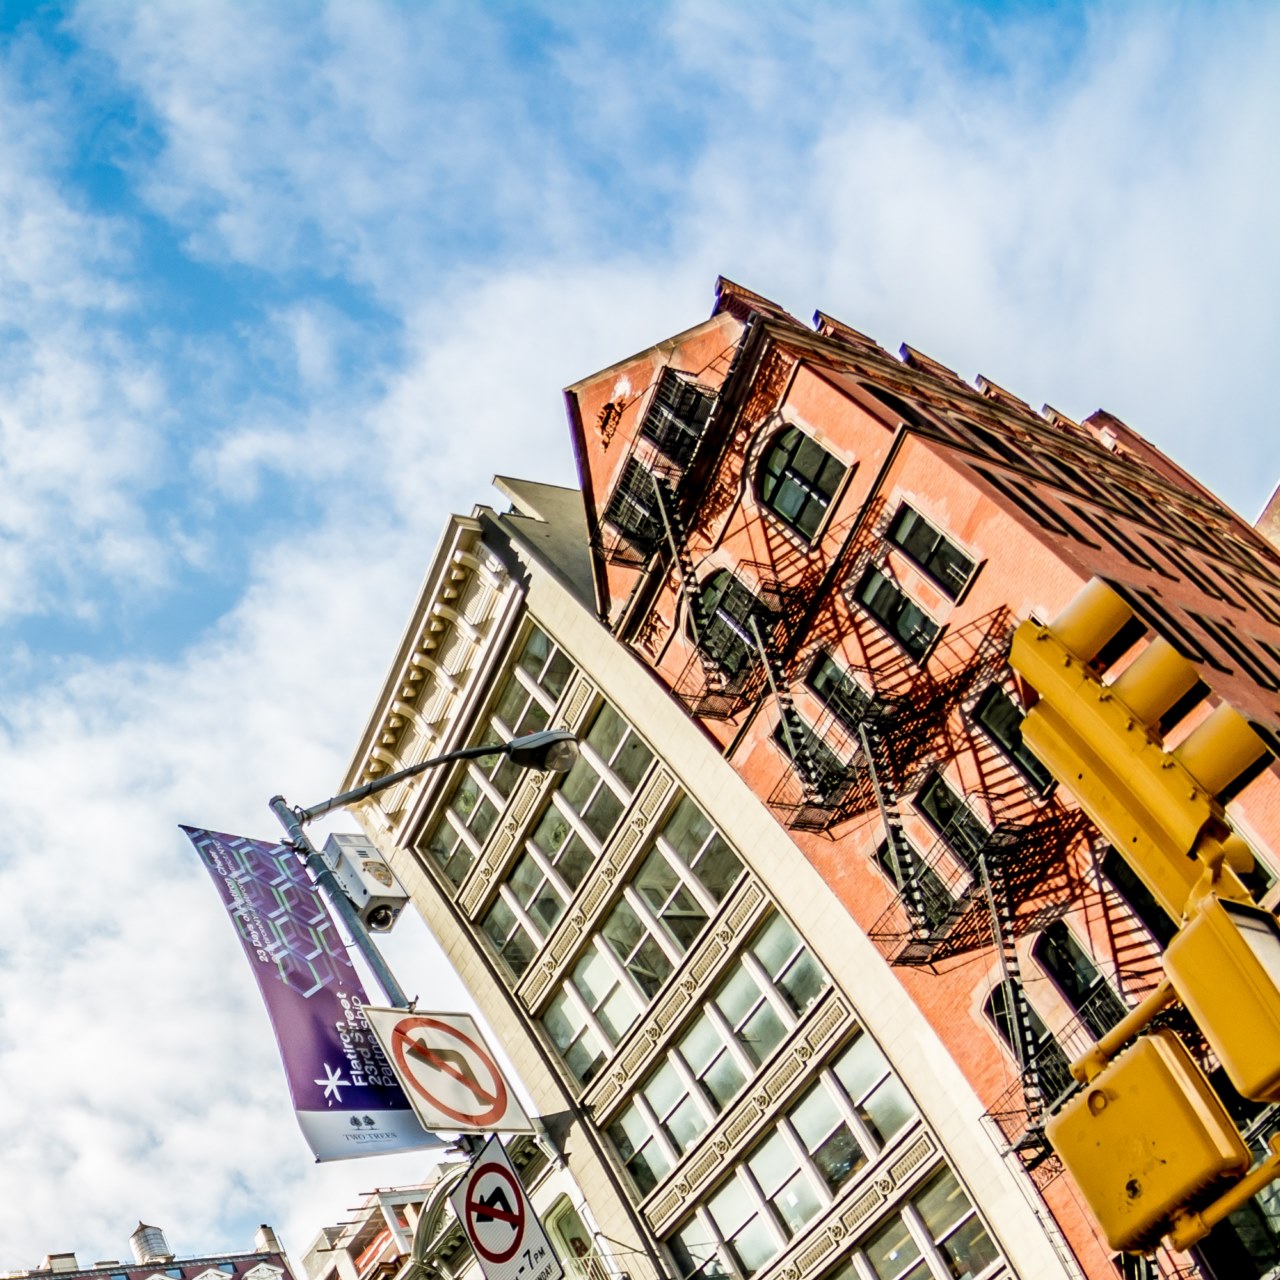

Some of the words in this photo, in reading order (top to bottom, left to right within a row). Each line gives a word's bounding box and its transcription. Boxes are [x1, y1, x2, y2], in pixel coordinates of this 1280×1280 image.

[209, 850, 227, 876] Cheer
[247, 923, 262, 948] Days
[256, 949, 269, 963] 23
[336, 1021, 369, 1087] Flatiron
[362, 1047, 382, 1087] 23rd
[343, 1133, 366, 1142] TWO
[368, 1131, 398, 1141] TREES
